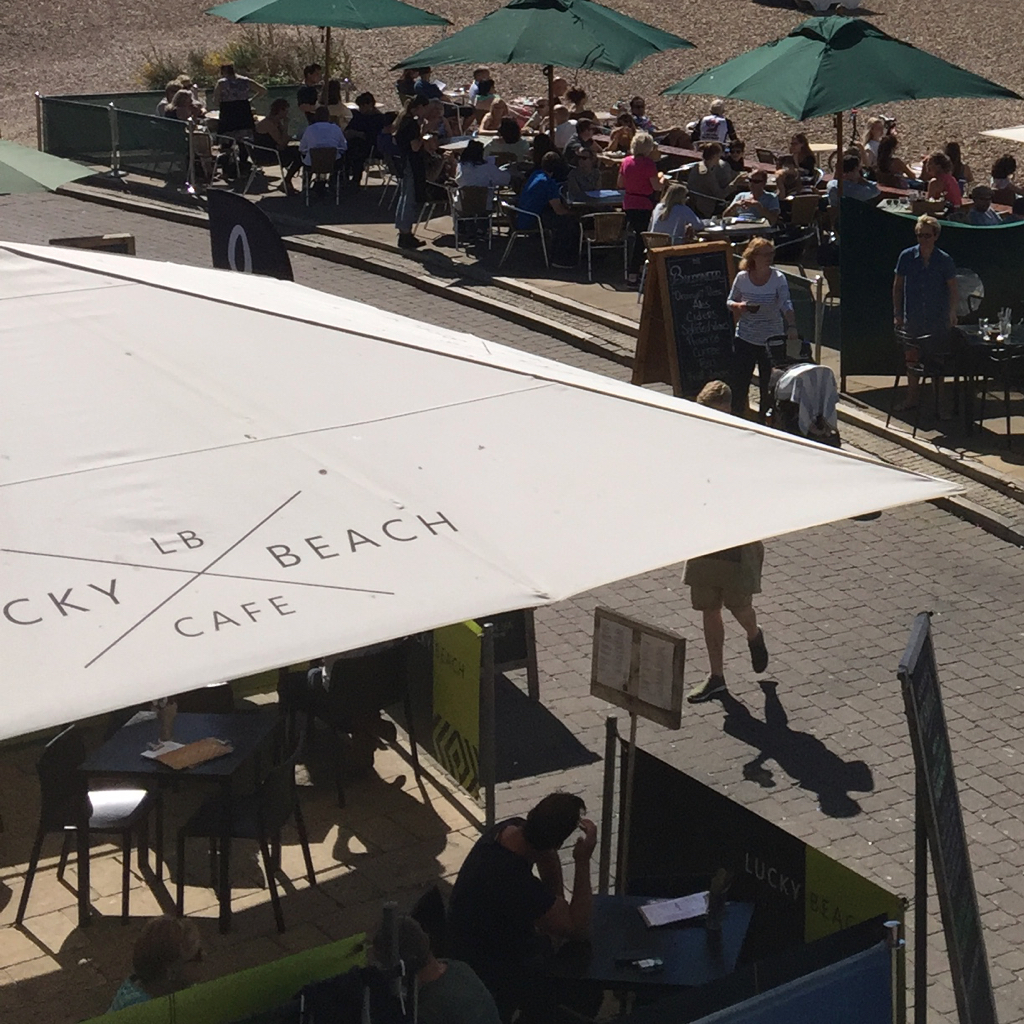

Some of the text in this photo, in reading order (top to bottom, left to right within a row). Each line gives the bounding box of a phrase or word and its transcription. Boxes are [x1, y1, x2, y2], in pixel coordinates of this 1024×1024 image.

[150, 529, 205, 555] LB
[265, 511, 460, 569] BEACH
[173, 595, 297, 639] CAFE
[744, 852, 801, 901] LUCKY
